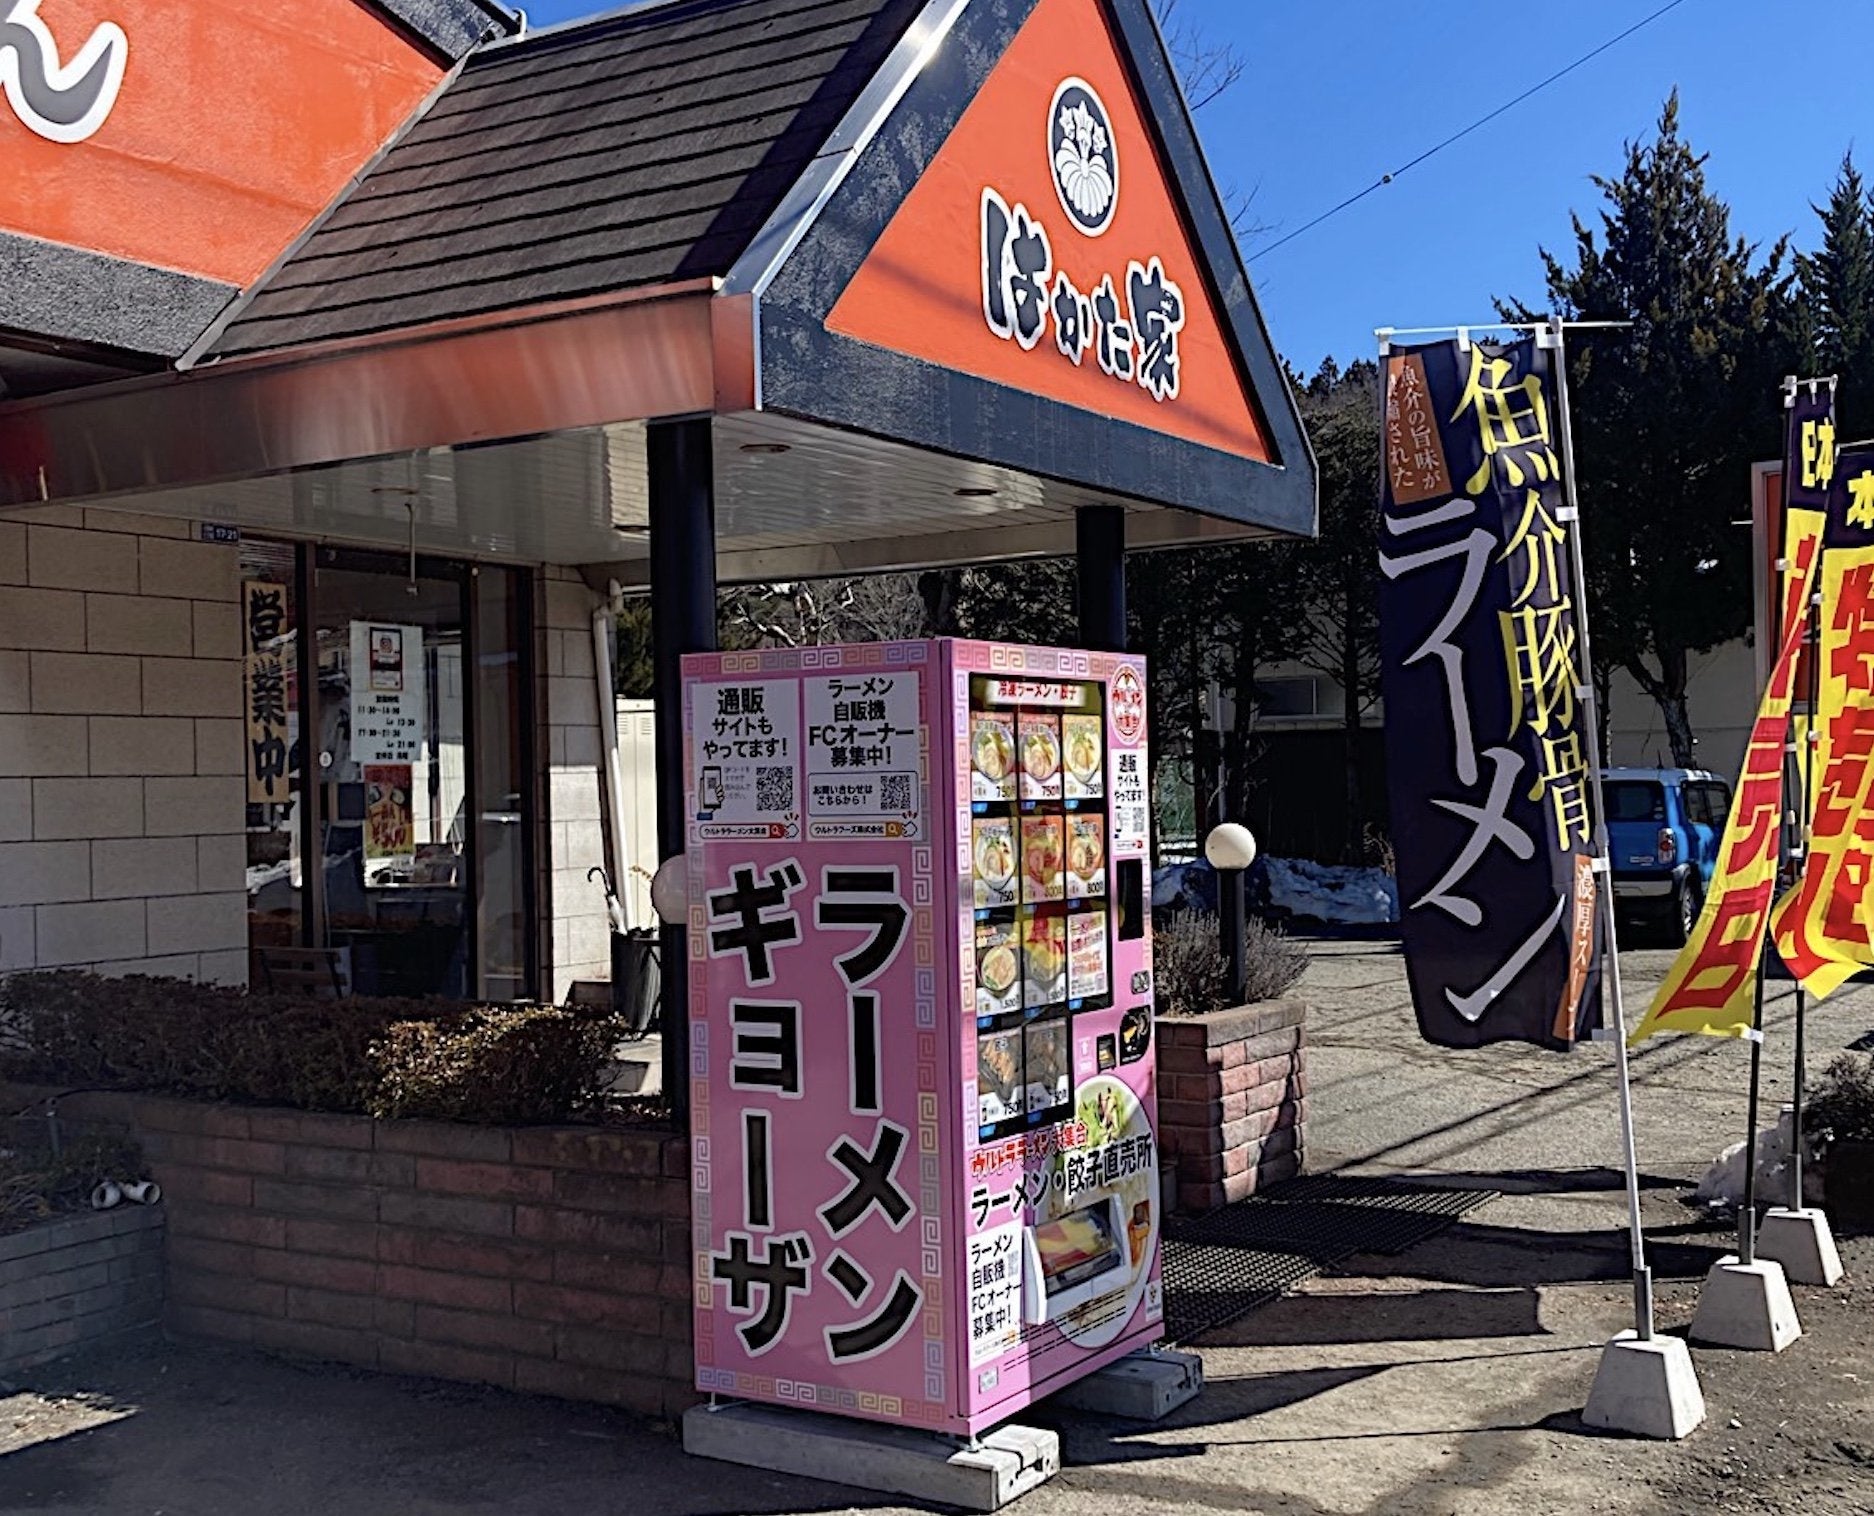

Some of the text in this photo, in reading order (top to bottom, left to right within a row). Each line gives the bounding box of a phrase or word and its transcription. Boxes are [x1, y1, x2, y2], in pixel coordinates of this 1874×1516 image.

[981, 187, 1185, 401] はかた家
[1400, 365, 1441, 489] 魚介の旨味が
[1450, 340, 1594, 852] 魚介豚骨
[249, 588, 287, 796] 営業中
[717, 686, 765, 715] 通販
[828, 677, 895, 699] ラーメン
[712, 717, 774, 737] サイトも
[833, 700, 887, 723] 自販機
[808, 723, 915, 747] FCオーナー
[831, 746, 892, 768] 募集中!
[1119, 754, 1137, 772] 通販
[1379, 498, 1567, 1022] ラーメン
[812, 784, 873, 795] お問い合わせは
[708, 859, 811, 1355] ギョーザ
[817, 867, 922, 1362] ラーメン
[971, 1234, 1013, 1265] ラーメン
[972, 1258, 1005, 1291] 自販機
[971, 1282, 1022, 1313] FCオーナー
